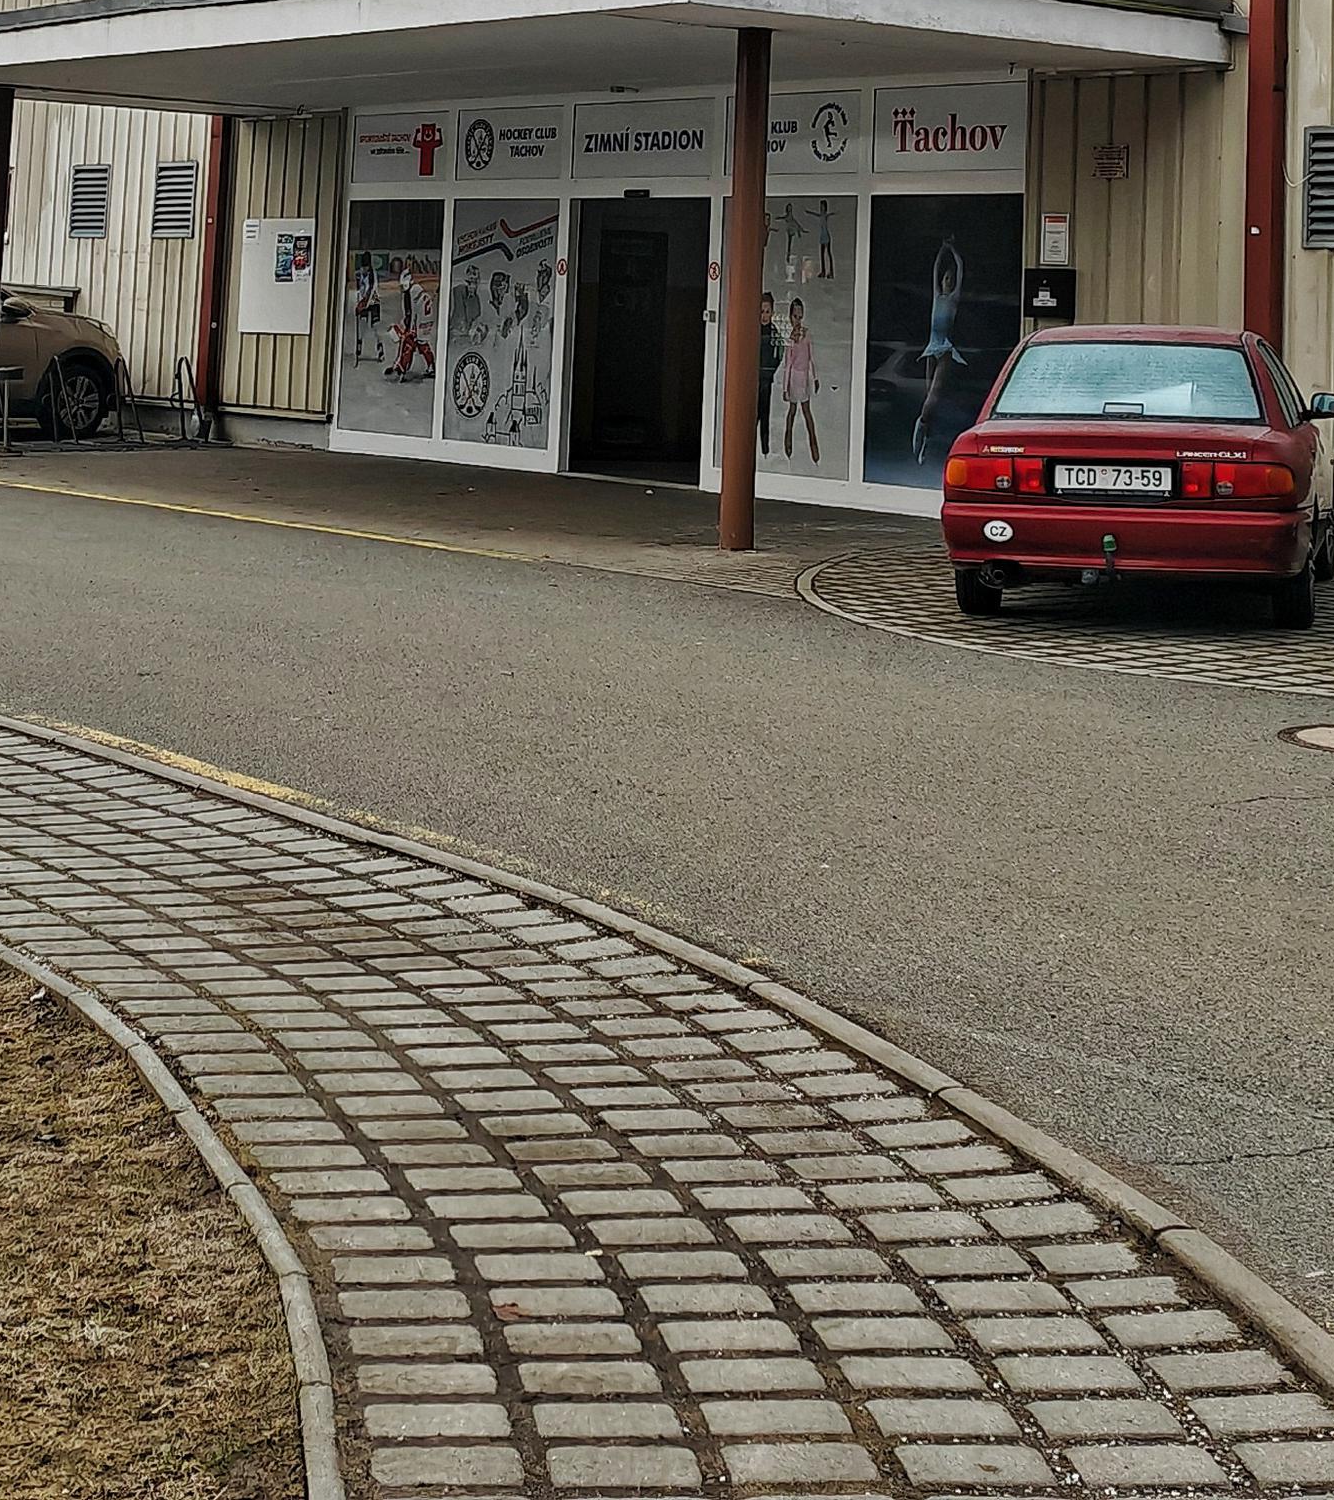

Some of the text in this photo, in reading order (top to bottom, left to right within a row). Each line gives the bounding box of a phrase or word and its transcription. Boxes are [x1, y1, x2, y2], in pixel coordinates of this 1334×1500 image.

[499, 127, 557, 142] HOCKEY CLUB
[771, 121, 798, 134] KLUB
[893, 108, 1008, 152] Tachov
[584, 126, 704, 153] ZIMNÍ STADION
[510, 145, 545, 158] TACHOV
[1064, 467, 1163, 488] TCD 73-59
[989, 525, 1008, 537] CZ
